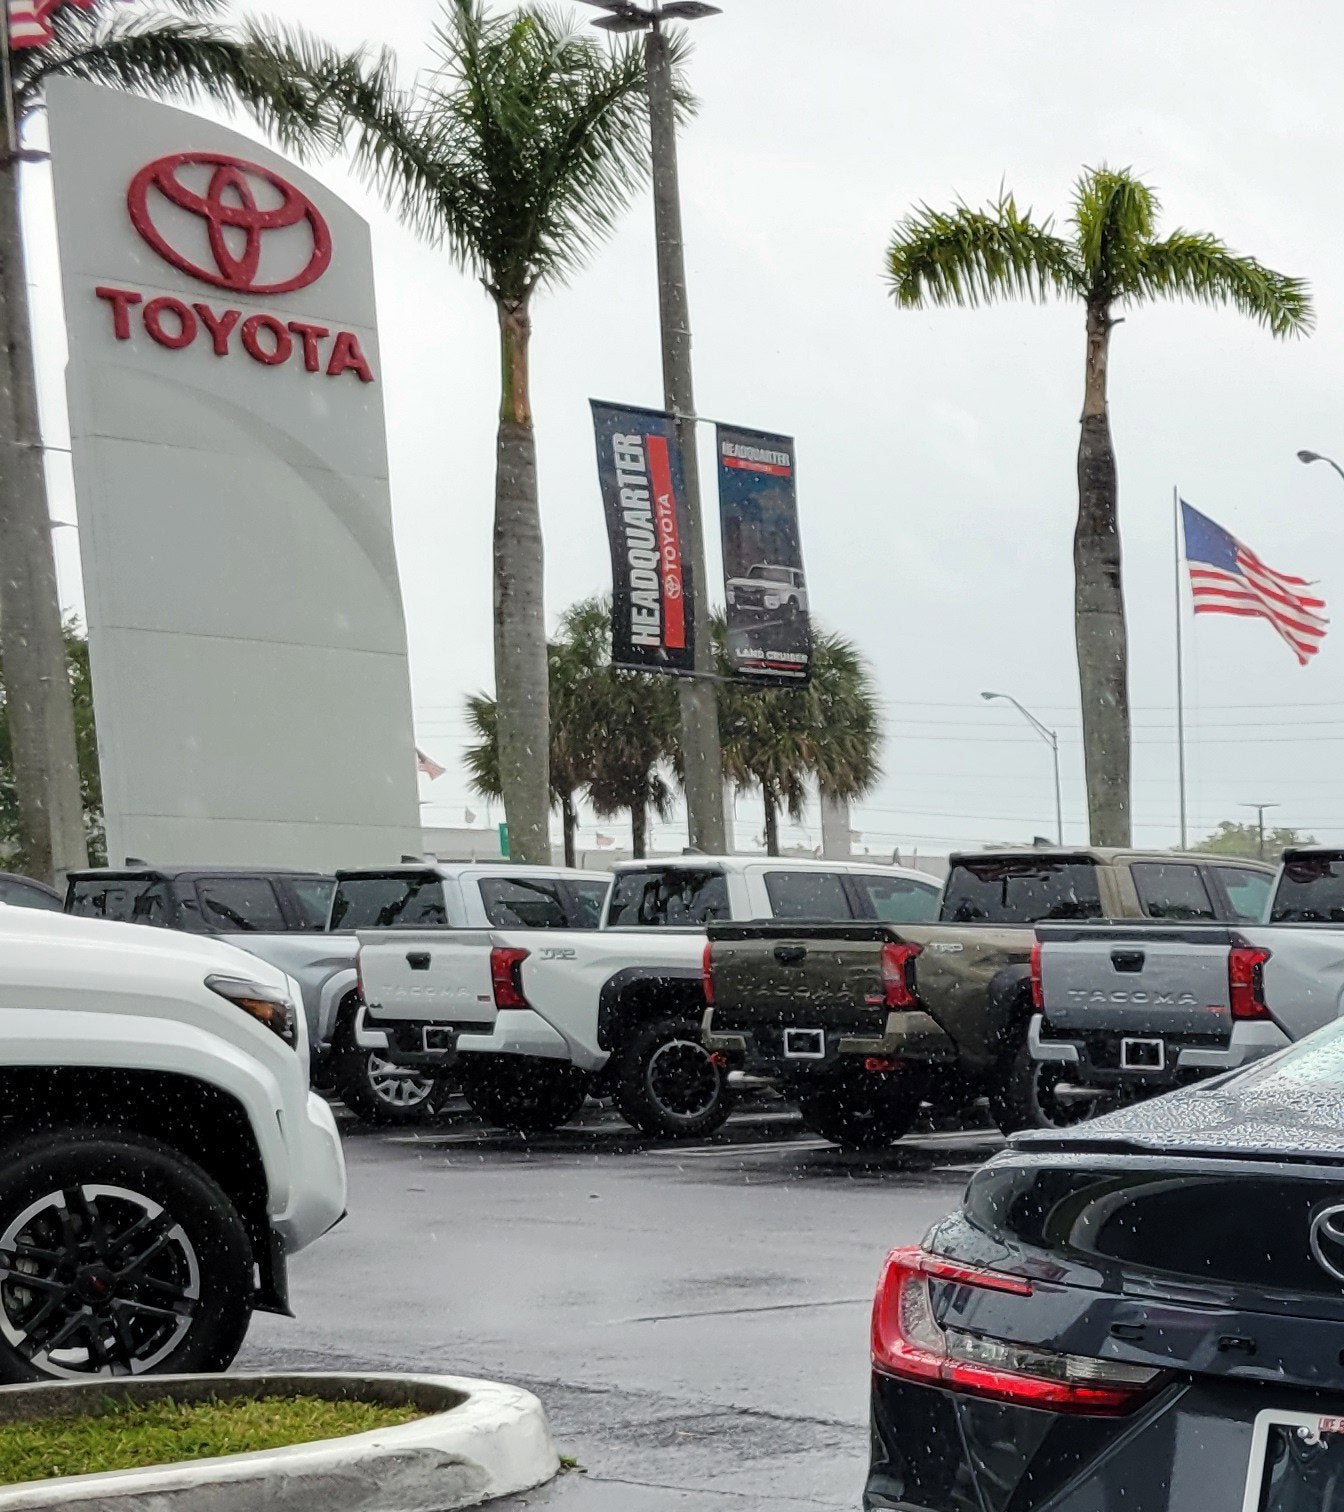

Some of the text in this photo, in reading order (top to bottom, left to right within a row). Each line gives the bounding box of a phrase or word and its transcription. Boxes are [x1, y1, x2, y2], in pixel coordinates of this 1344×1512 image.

[95, 286, 375, 383] TOYOTA
[612, 432, 661, 647] HEADQUARTER
[655, 493, 681, 572] TOYOTA
[1066, 988, 1199, 1005] TACOMA
